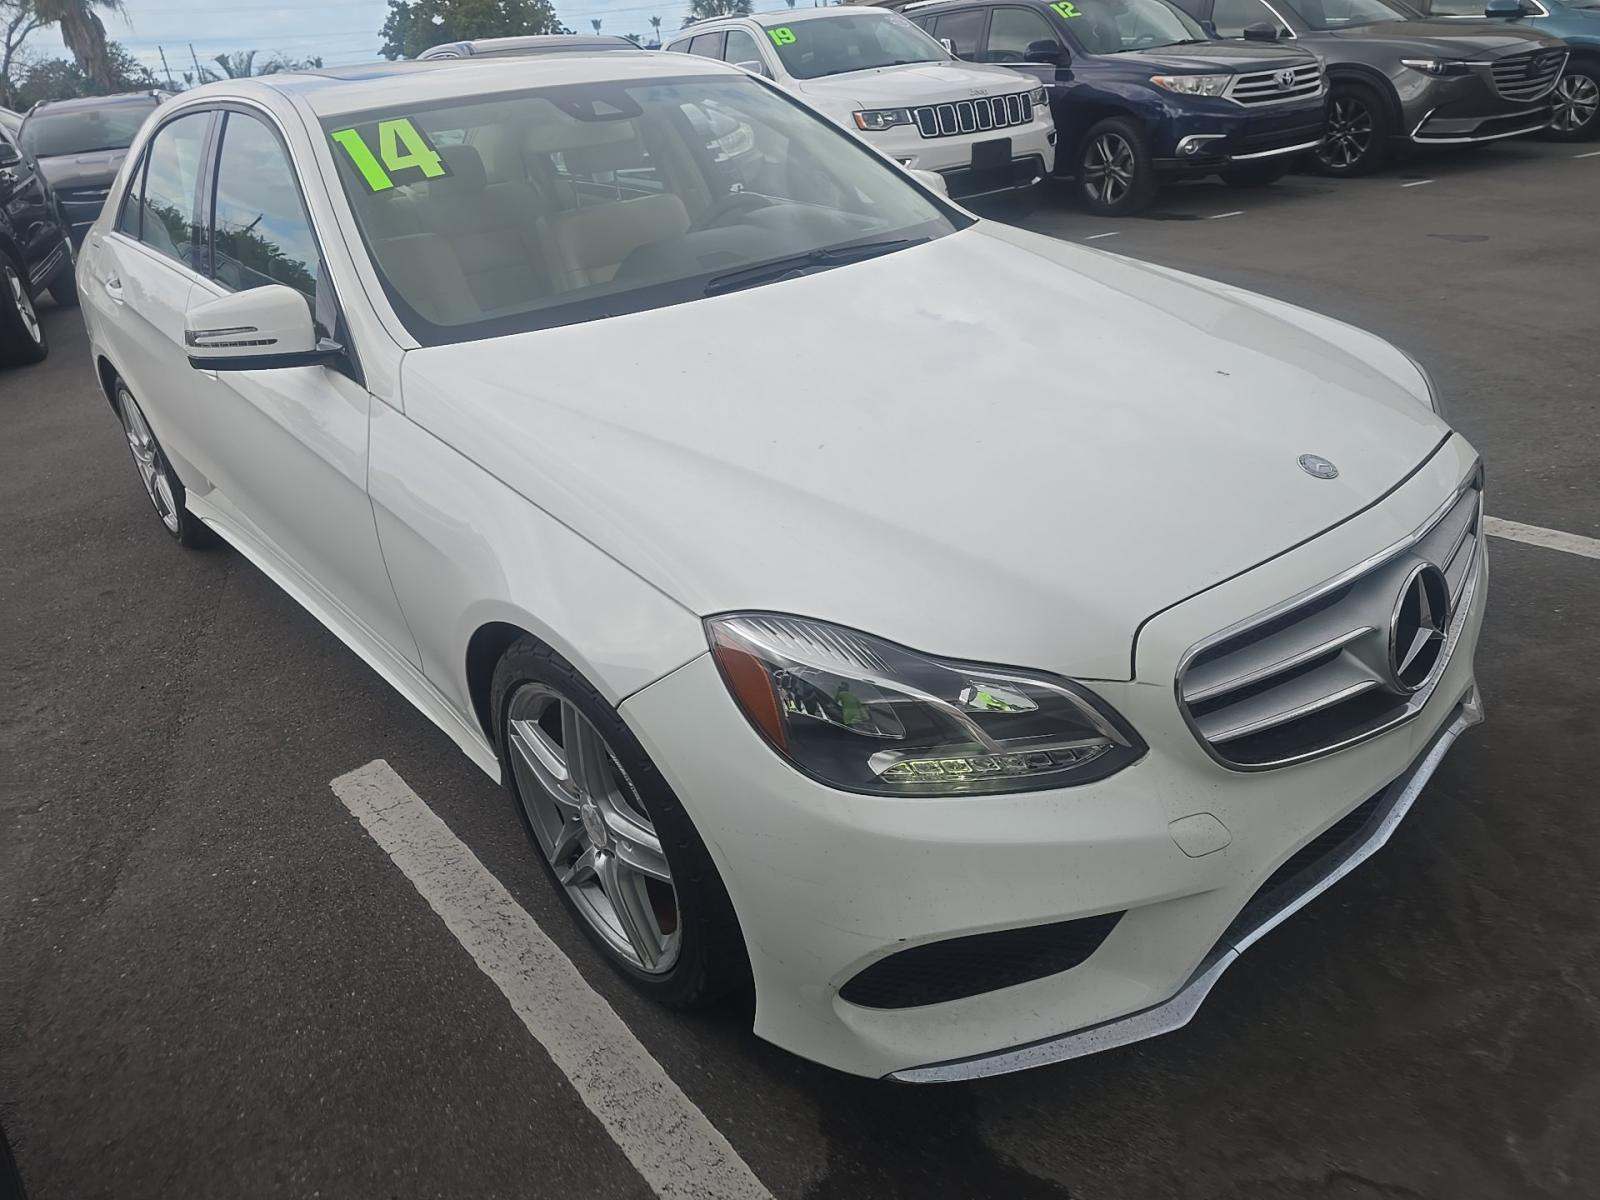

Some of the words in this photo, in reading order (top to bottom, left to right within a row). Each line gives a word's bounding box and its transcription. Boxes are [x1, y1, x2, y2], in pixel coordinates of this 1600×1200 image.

[1049, 1, 1082, 18] 12
[767, 27, 796, 46] 19
[331, 118, 446, 192] 14
